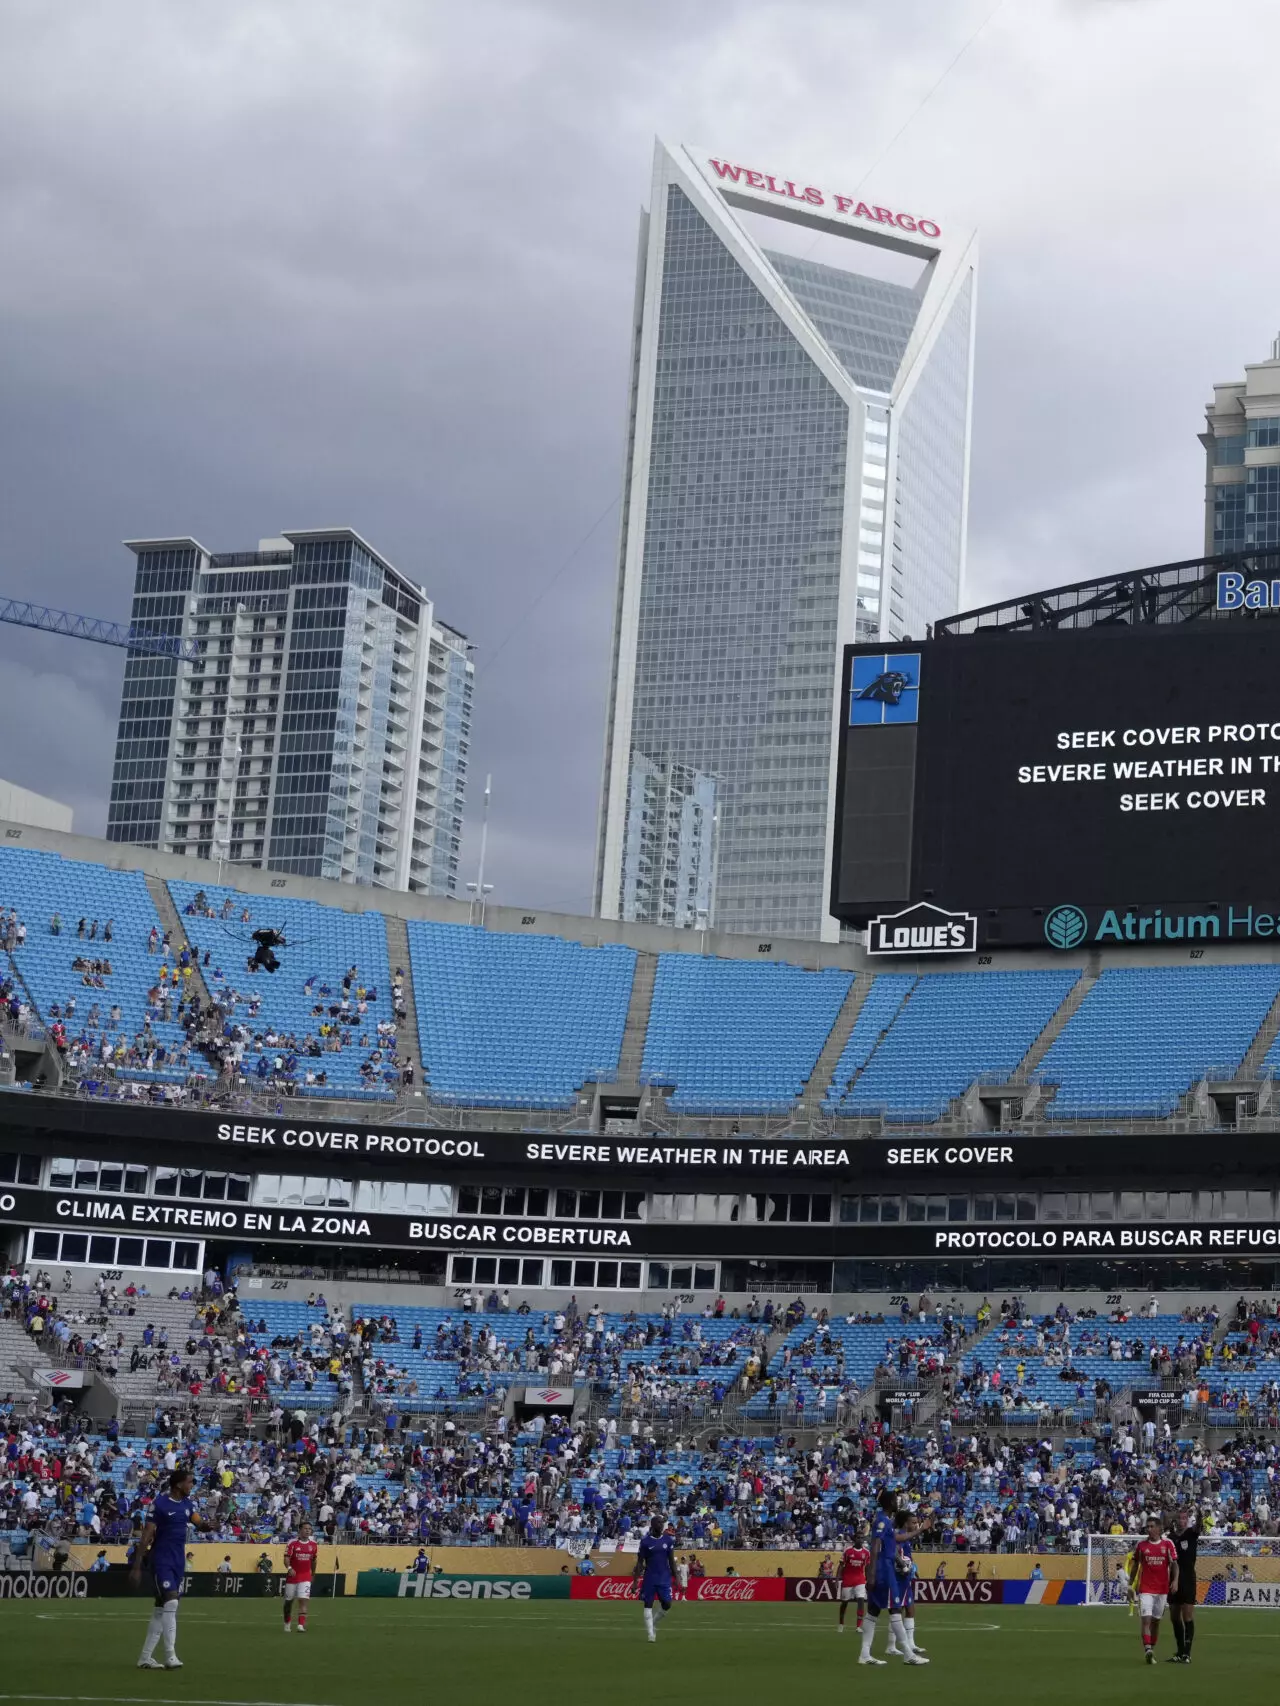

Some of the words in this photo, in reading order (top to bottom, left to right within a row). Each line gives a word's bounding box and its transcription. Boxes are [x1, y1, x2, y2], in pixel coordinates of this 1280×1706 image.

[709, 158, 825, 206] WELLS
[833, 194, 942, 238] FARGO
[1056, 730, 1116, 750] SEEK
[1122, 726, 1201, 746] COVER
[1017, 762, 1107, 784] SEVERE
[1112, 757, 1225, 779] WEATHER
[1230, 756, 1252, 775] IN
[1119, 792, 1180, 812] SEEK
[1186, 788, 1266, 809] COVER
[878, 921, 966, 949] LOWE'S
[1095, 908, 1220, 941] Atrium
[1190, 950, 1204, 959] 527
[217, 1123, 277, 1145] SEEK
[282, 1129, 359, 1150] COVER
[365, 1134, 485, 1157] PROTOCOL
[526, 1143, 611, 1162] SEVERE
[616, 1146, 717, 1164] WEATHER
[722, 1148, 743, 1165] IN
[748, 1148, 788, 1165] THE
[792, 1148, 850, 1165] AREA
[886, 1147, 940, 1165] SEEK
[944, 1146, 1014, 1164] COVER
[56, 1199, 126, 1221] CLIMA
[131, 1204, 238, 1228] EXTREMO
[243, 1213, 272, 1231] EN
[278, 1215, 307, 1233] LA
[311, 1217, 371, 1236] ZONA
[409, 1222, 497, 1242] BUSCAR
[502, 1226, 632, 1246] COBERTURA
[935, 1231, 1057, 1248] PROTOCOLO
[1062, 1230, 1116, 1247] PARA
[1120, 1229, 1203, 1246] BUSCAR
[105, 1270, 123, 1281] 323
[270, 1280, 288, 1290] 224
[1105, 1295, 1122, 1305] 228
[224, 1577, 244, 1594] PIF
[397, 1573, 532, 1599] Hisense
[795, 1579, 843, 1601] QAT
[914, 1580, 993, 1602] RWAYS
